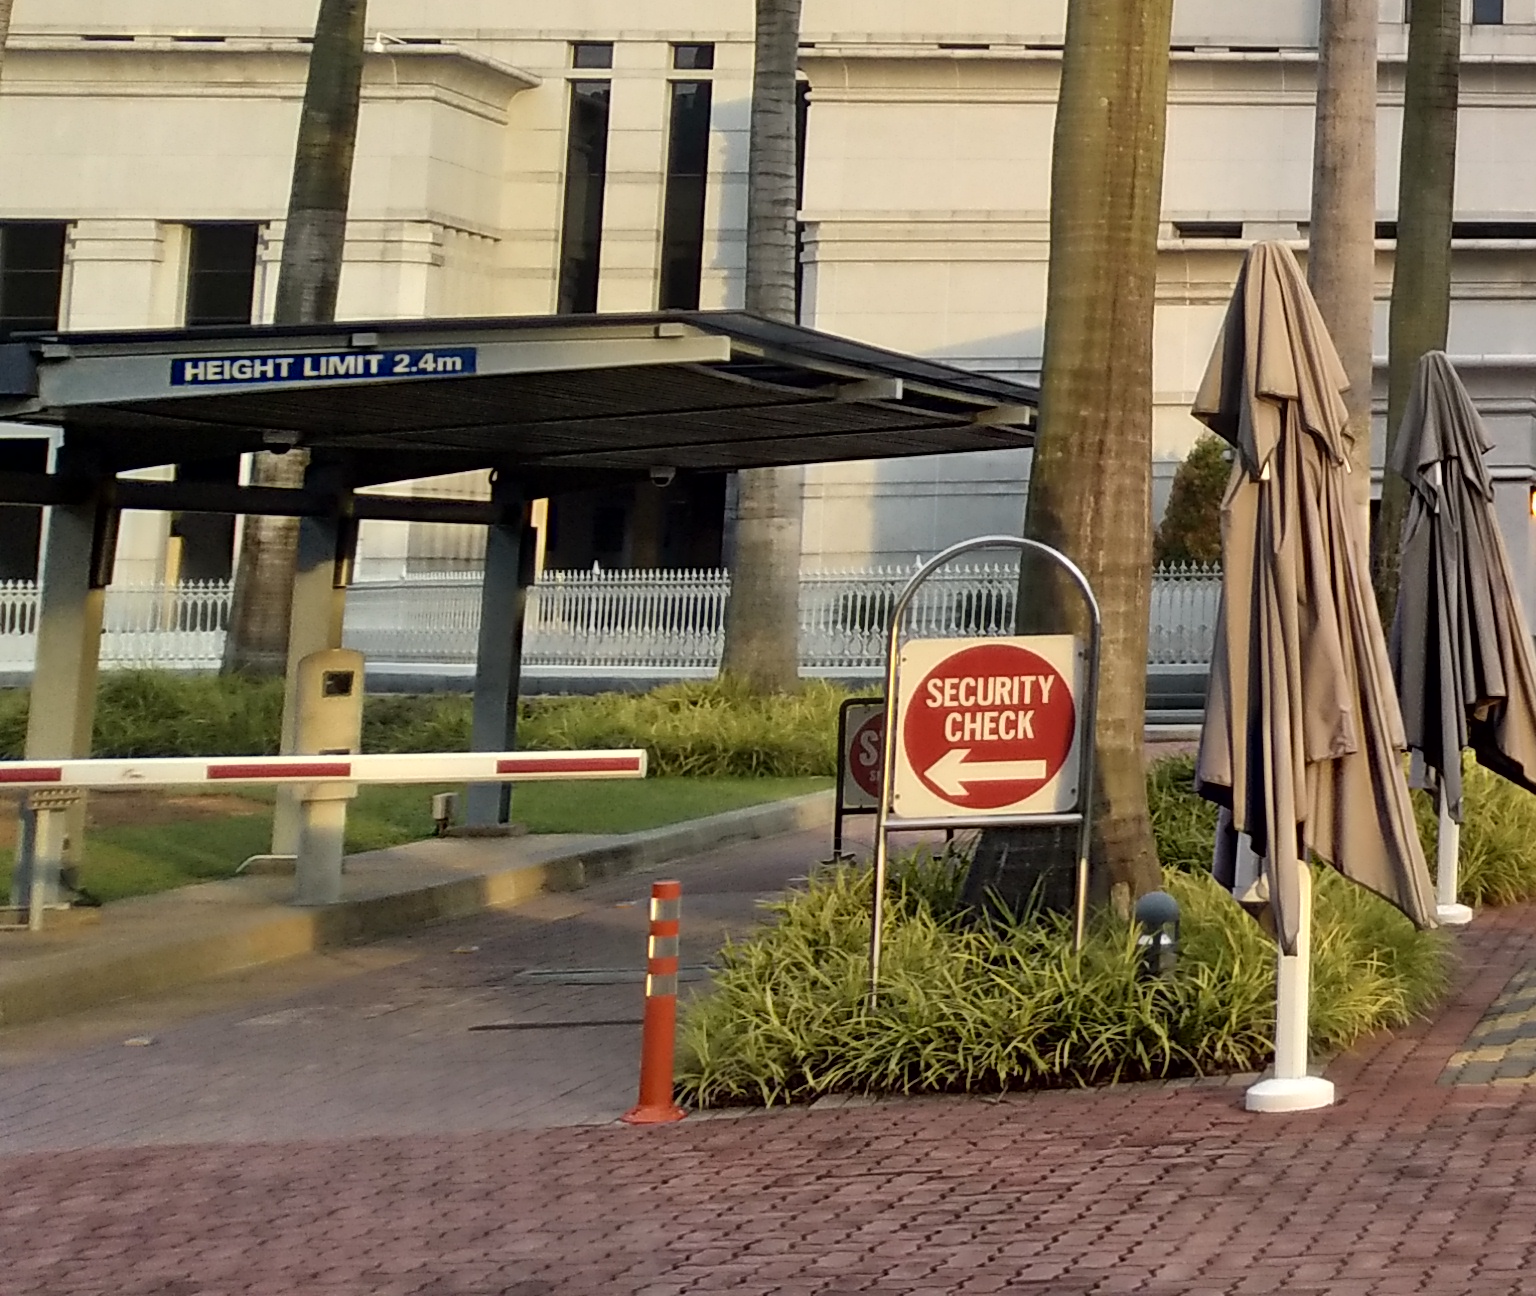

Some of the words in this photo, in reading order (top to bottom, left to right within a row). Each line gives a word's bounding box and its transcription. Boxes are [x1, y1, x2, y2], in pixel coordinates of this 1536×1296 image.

[183, 357, 294, 382] HEIGHT
[303, 354, 383, 377] LIMIT
[393, 352, 463, 374] 2.4m
[925, 675, 1055, 708] SECURITY
[944, 710, 1035, 742] CHECK
